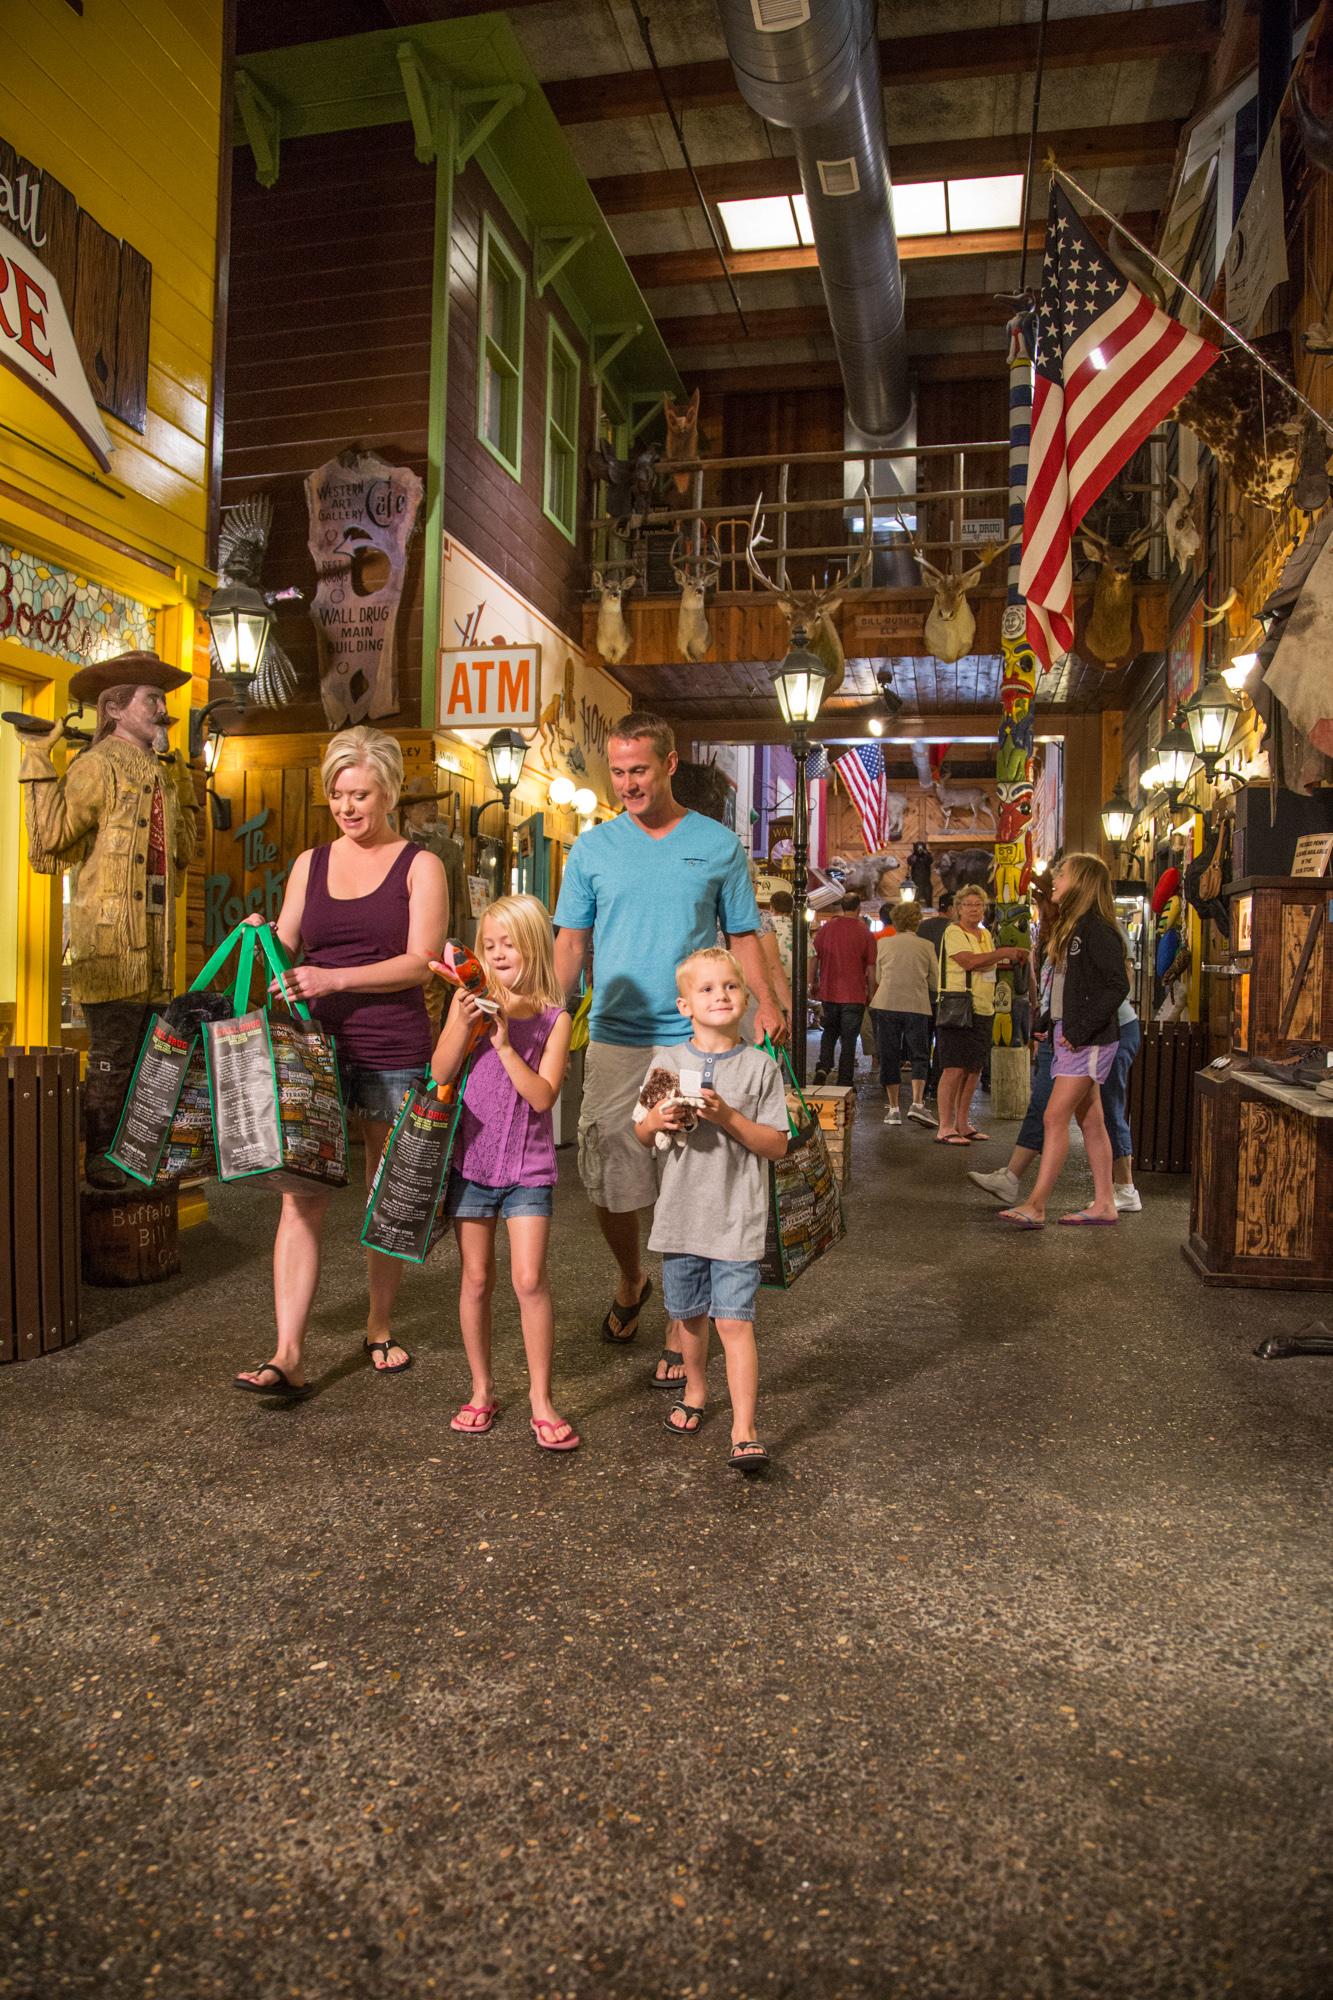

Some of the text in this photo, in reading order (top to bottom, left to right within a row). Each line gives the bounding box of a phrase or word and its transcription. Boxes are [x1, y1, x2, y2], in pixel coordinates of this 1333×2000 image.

[317, 482, 364, 500] WESTERN
[331, 499, 353, 510] ART
[319, 510, 364, 522] GALLERY
[319, 606, 389, 626] WALL DRUG
[341, 626, 374, 638] MAIN
[327, 638, 385, 655] BUILDING
[447, 659, 530, 715] ATM
[234, 807, 277, 872] The
[773, 827, 793, 838] WA
[167, 1034, 189, 1049] DRUG
[427, 1109, 450, 1122] DRUG
[111, 1202, 171, 1228] Buffalo
[139, 1225, 166, 1248] Bill
